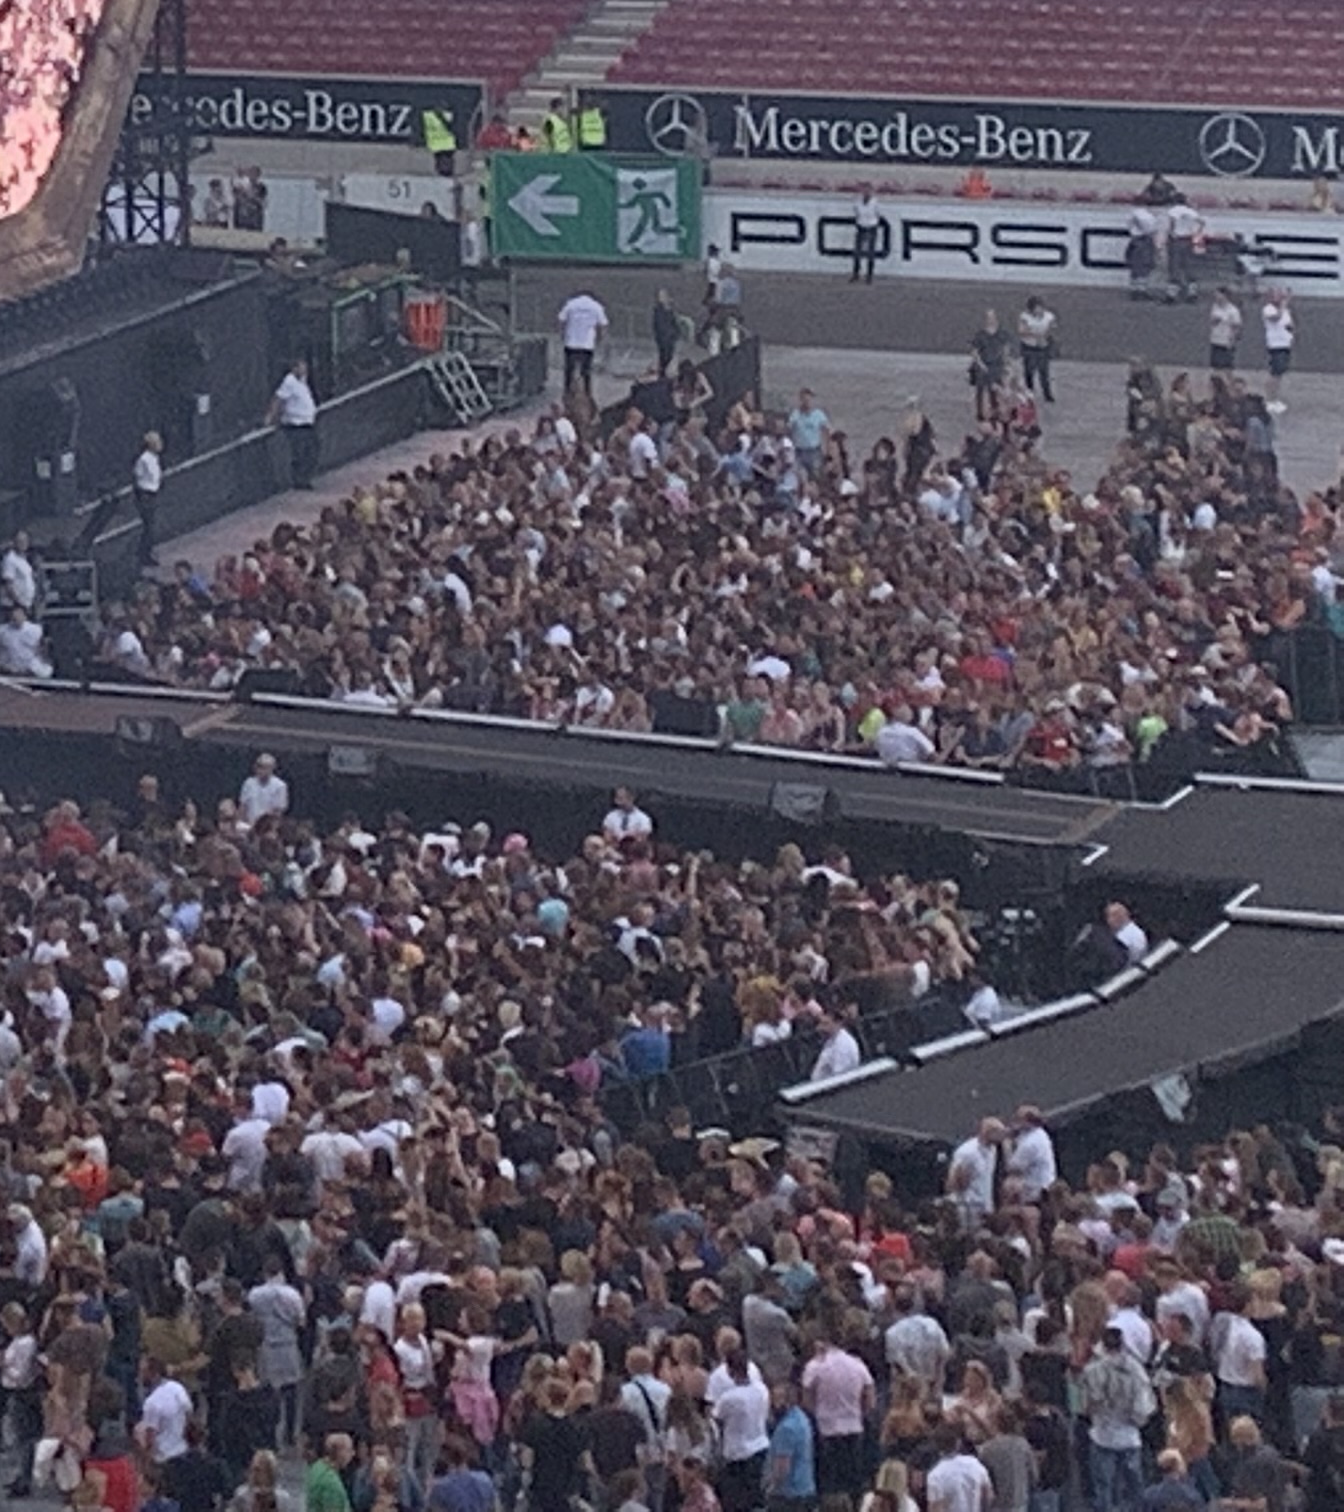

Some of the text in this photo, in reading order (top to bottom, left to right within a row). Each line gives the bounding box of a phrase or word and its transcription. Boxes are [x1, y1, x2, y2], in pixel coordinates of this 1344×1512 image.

[733, 105, 1093, 162] Mercedes-Benz
[1291, 125, 1344, 172] M
[386, 178, 412, 199] 51
[730, 212, 1339, 279] PORSCE
